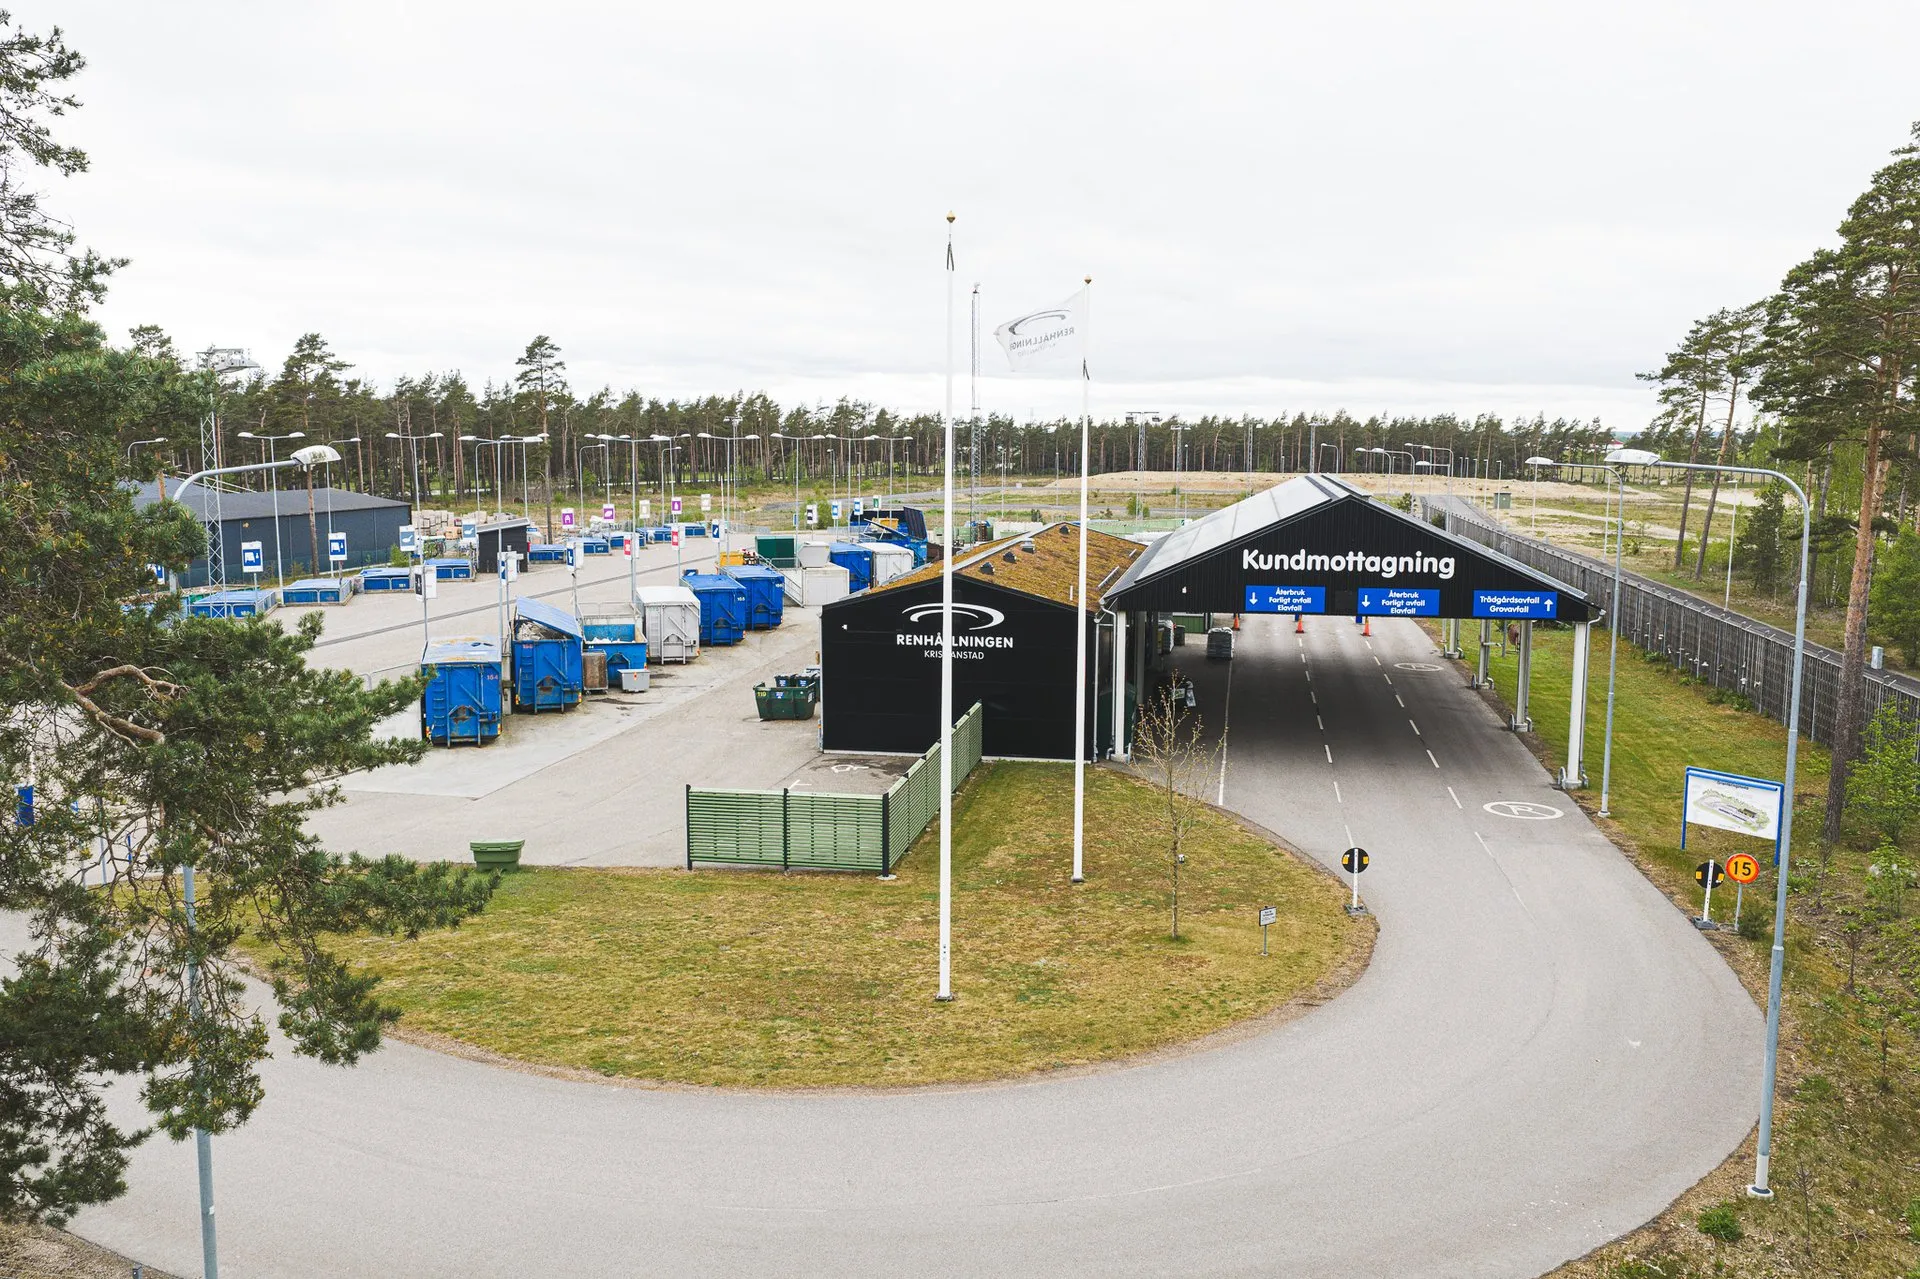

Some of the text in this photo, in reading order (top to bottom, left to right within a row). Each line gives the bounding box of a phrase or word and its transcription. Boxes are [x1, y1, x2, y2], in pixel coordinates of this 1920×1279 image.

[1242, 549, 1455, 579] Kundmottagning
[1275, 587, 1305, 596] Återbruk
[1388, 590, 1419, 599] Återbruk
[1268, 596, 1291, 604] Farligt
[1381, 599, 1404, 607] Farligt
[1480, 595, 1540, 605] Trädgårdsavfall
[1277, 604, 1302, 612] Elavfall
[1489, 605, 1529, 613] Grovavfall
[896, 631, 1014, 649] RENHÅLNINGEN
[924, 649, 985, 660] KRISANSTAD
[1733, 861, 1752, 876] 15
